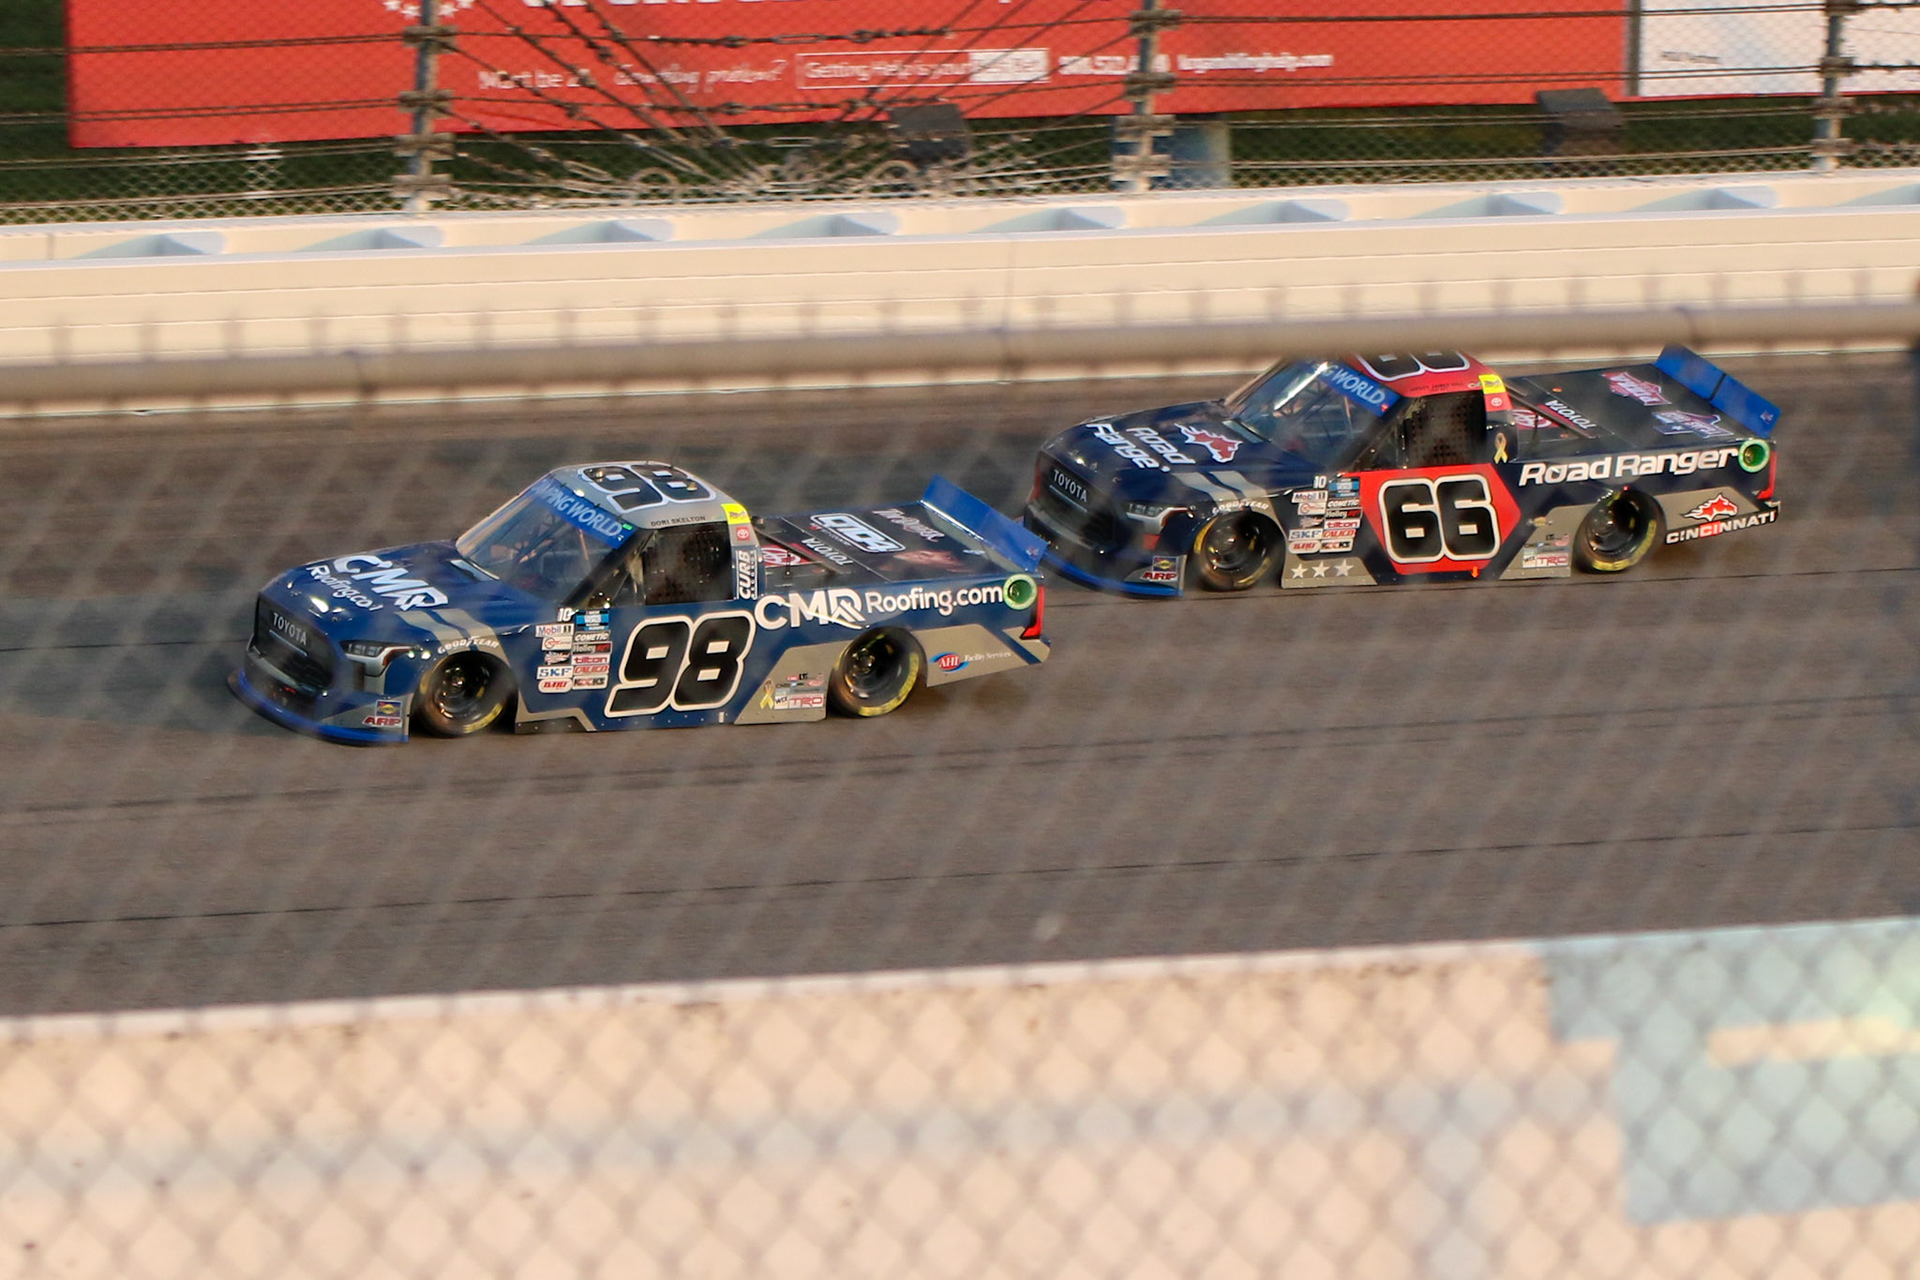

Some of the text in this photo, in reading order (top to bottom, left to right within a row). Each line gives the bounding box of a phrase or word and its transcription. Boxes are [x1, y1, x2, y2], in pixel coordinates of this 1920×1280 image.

[1331, 368, 1386, 405] WORLD
[1545, 400, 1597, 430] TOYOTA
[1086, 423, 1197, 473] Road Range
[1313, 476, 1327, 489] 10
[1518, 448, 1739, 487] Road Ranger
[577, 464, 717, 514] 98
[1053, 469, 1088, 503] TOYOTA
[566, 500, 623, 537] WORLD
[671, 515, 706, 525] SKELTON
[1378, 474, 1501, 564] 66
[1656, 511, 1776, 544] CINCINNATI
[801, 537, 854, 566] TOYOTA
[333, 555, 449, 612] CMR
[738, 550, 751, 600] CURB
[1141, 571, 1178, 581] ARP
[754, 586, 1004, 630] CMR Roofing.com
[272, 611, 308, 647] TOYOTA
[437, 635, 500, 655] GOODYEAR
[538, 626, 561, 635] Mobil
[574, 633, 609, 641] COMETIC
[604, 610, 756, 718] 98
[986, 651, 1011, 660] Services
[539, 668, 572, 677] SKF
[362, 715, 403, 728] ARP
